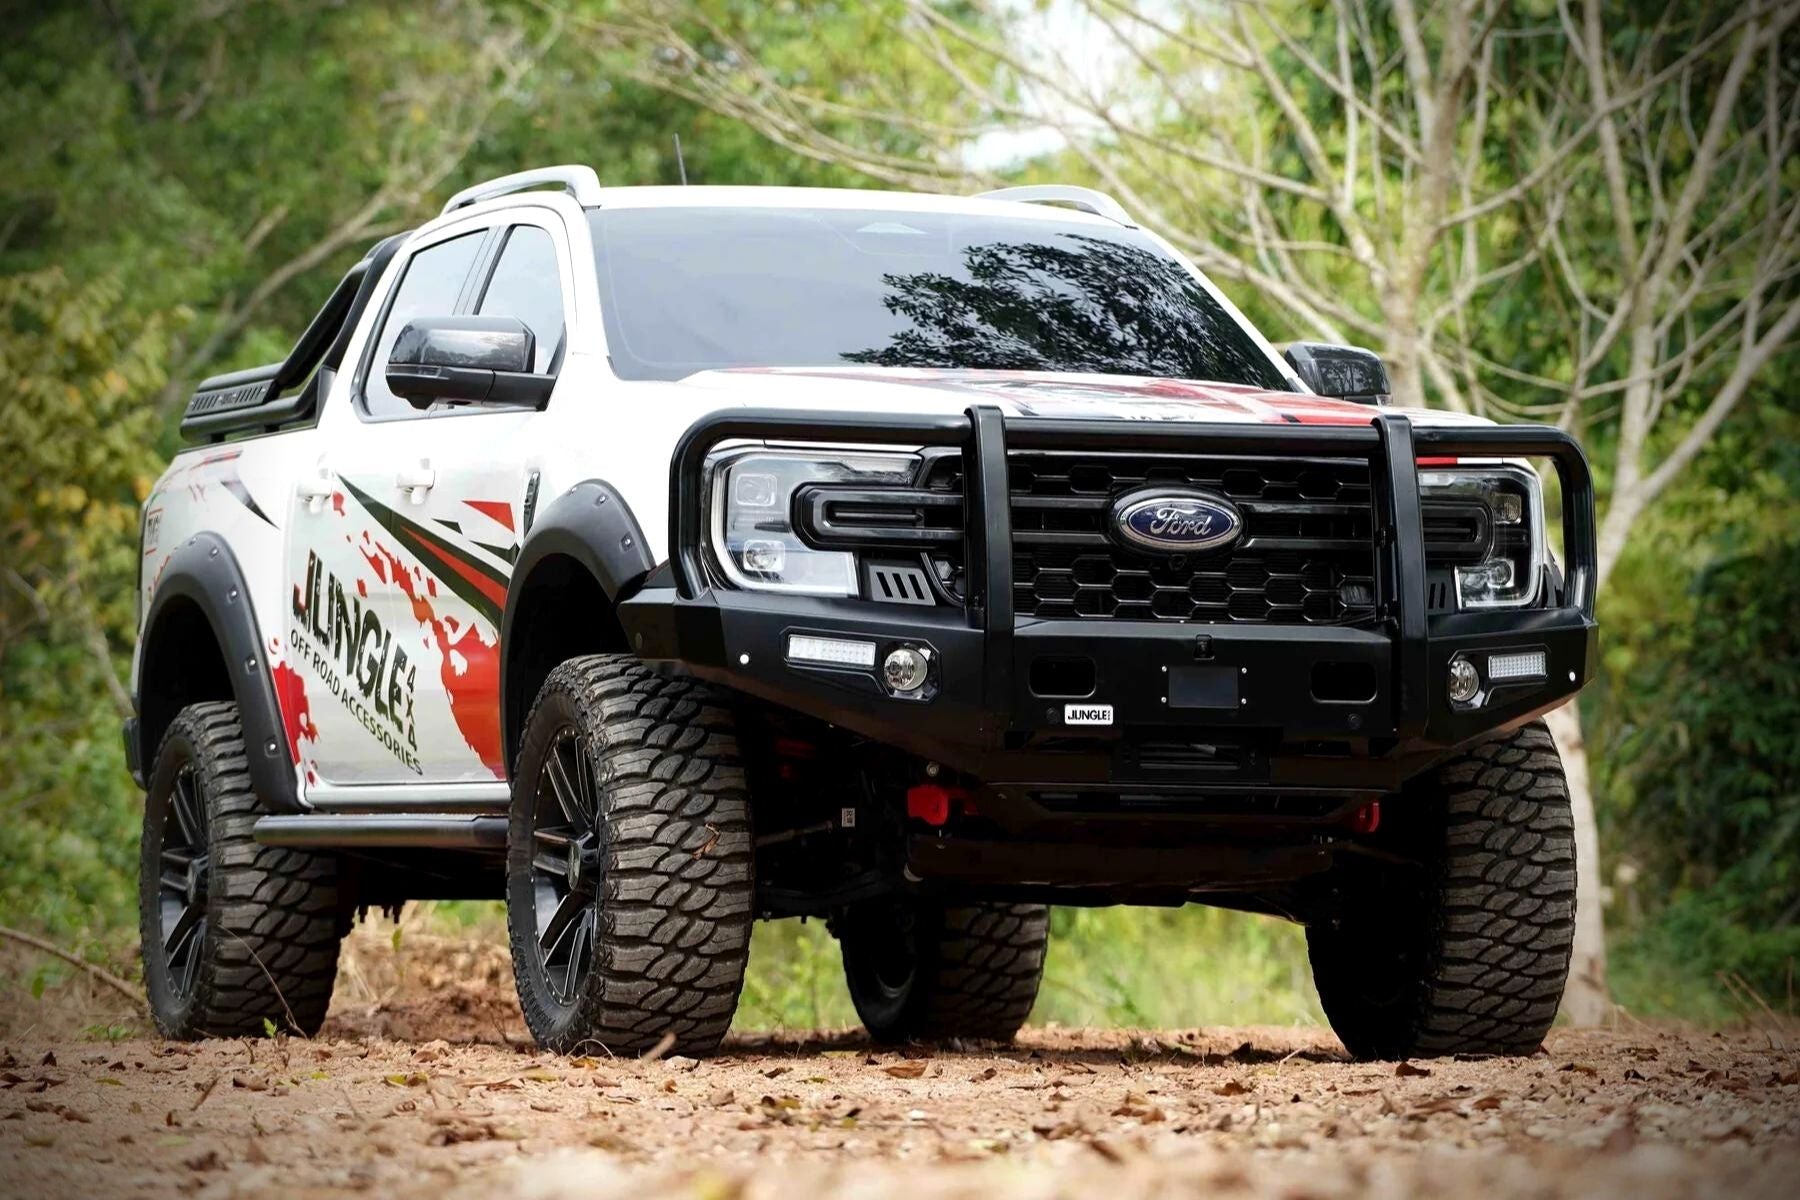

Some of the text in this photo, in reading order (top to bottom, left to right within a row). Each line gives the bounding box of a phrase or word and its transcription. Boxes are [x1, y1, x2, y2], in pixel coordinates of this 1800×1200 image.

[1150, 507, 1212, 535] Ford
[293, 548, 409, 735] JUNGLE
[290, 628, 424, 776] OFF ROAD ACCESSORIES
[1067, 709, 1107, 721] JUNGLE
